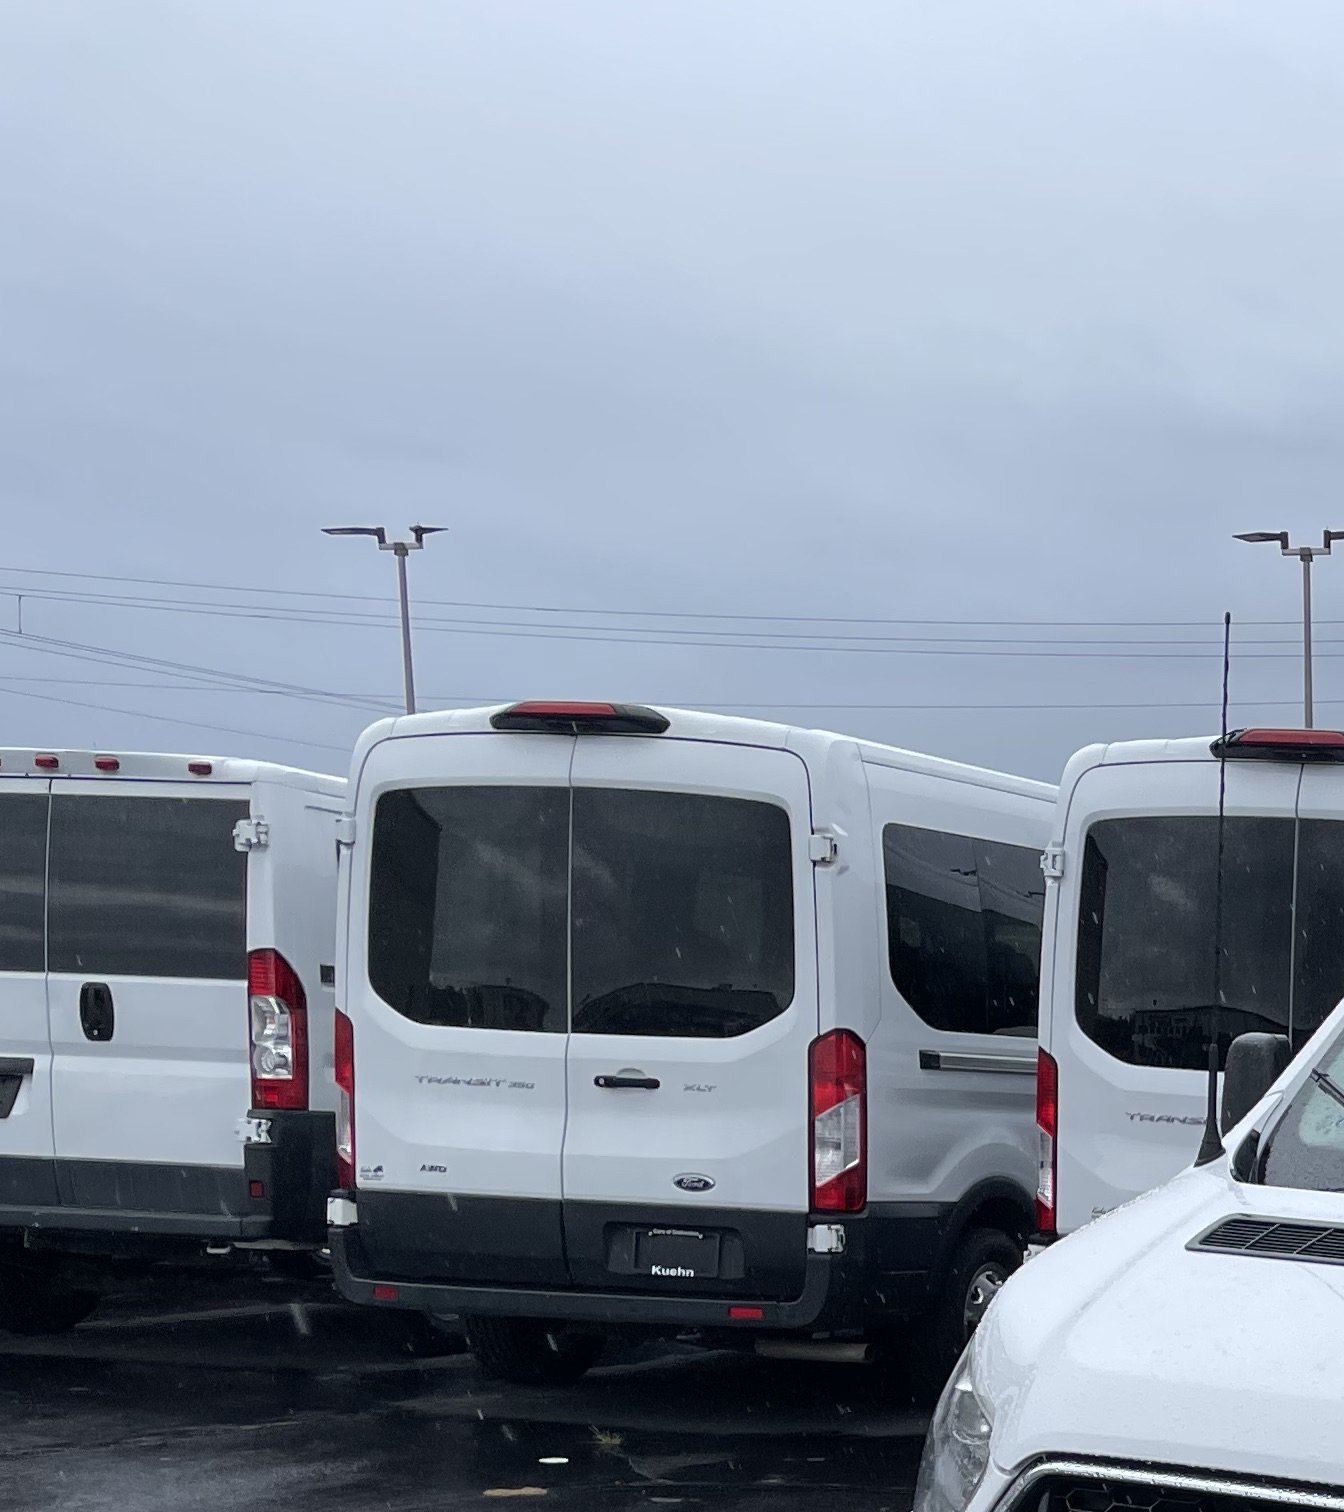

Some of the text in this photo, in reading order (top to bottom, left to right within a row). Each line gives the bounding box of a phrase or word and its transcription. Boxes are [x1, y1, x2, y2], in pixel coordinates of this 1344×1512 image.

[415, 1075, 506, 1087] TRANSIT
[683, 1083, 717, 1093] XLT
[420, 1164, 447, 1173] AWD
[651, 1265, 695, 1278] Kuehn
